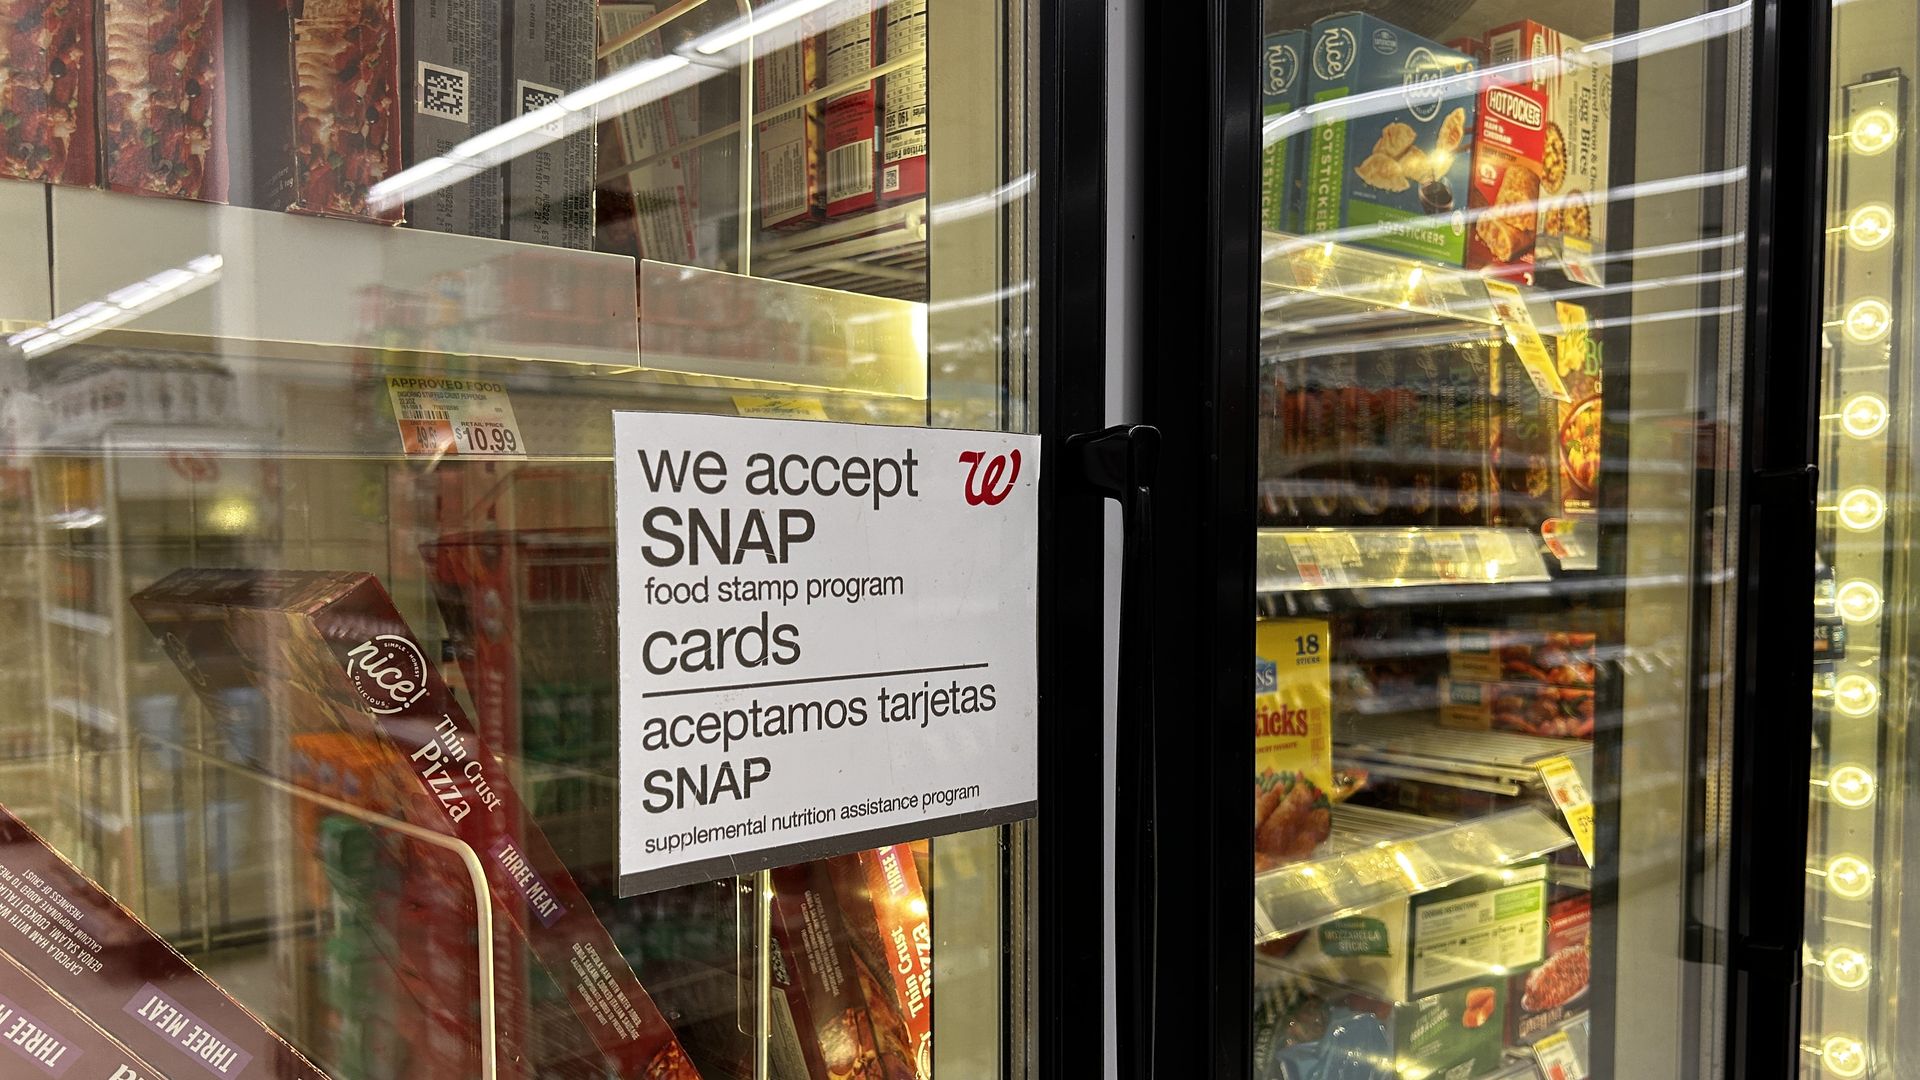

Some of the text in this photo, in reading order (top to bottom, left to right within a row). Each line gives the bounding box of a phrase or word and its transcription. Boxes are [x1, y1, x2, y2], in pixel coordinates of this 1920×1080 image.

[1324, 28, 1346, 80] nice!
[1580, 86, 1591, 176] Egg Bites
[542, 174, 549, 184] BY
[392, 378, 502, 392] APPROVED FOOD
[456, 427, 517, 452] $10.99
[638, 448, 919, 510] we accept
[641, 506, 816, 567] SNAP
[645, 574, 904, 606] food stamp program
[383, 642, 420, 678] SIMPLE HONEST
[642, 611, 801, 675] cards
[1295, 634, 1319, 656] 18
[347, 640, 427, 709] nice!
[354, 675, 386, 707] DELICIOUS
[642, 681, 996, 752] aceptamos tarjetas
[410, 738, 474, 824] Pizza
[434, 713, 503, 812] Thin Crust
[642, 756, 772, 814] SNAP
[645, 783, 980, 854] supplemental nutrition assistance program
[10, 877, 23, 887] TO
[498, 844, 558, 918] THREE MEAT
[882, 853, 907, 895] THREE
[18, 884, 43, 904] ADDED
[20, 868, 85, 920] FRESHNESS OF CRUST
[7, 913, 32, 933] WITH
[18, 903, 51, 930] COOKED
[38, 900, 78, 932] PROPIONATE
[27, 929, 50, 948] HAM
[46, 925, 81, 953] SALAMI,
[73, 929, 103, 952] CALCIUM
[45, 944, 84, 975] CAPICOLA
[75, 949, 104, 972] GENOA
[890, 926, 925, 1018] Thin Crust
[572, 942, 586, 961] GENOA
[597, 979, 612, 1000] COOKED
[609, 997, 625, 1019] ITALIAN
[622, 1016, 639, 1040] SAUSAGE
[608, 977, 620, 994] WITH
[616, 990, 630, 1010] WATER
[4, 1016, 66, 1067] THREE
[137, 996, 238, 1073] THREE MEAT
